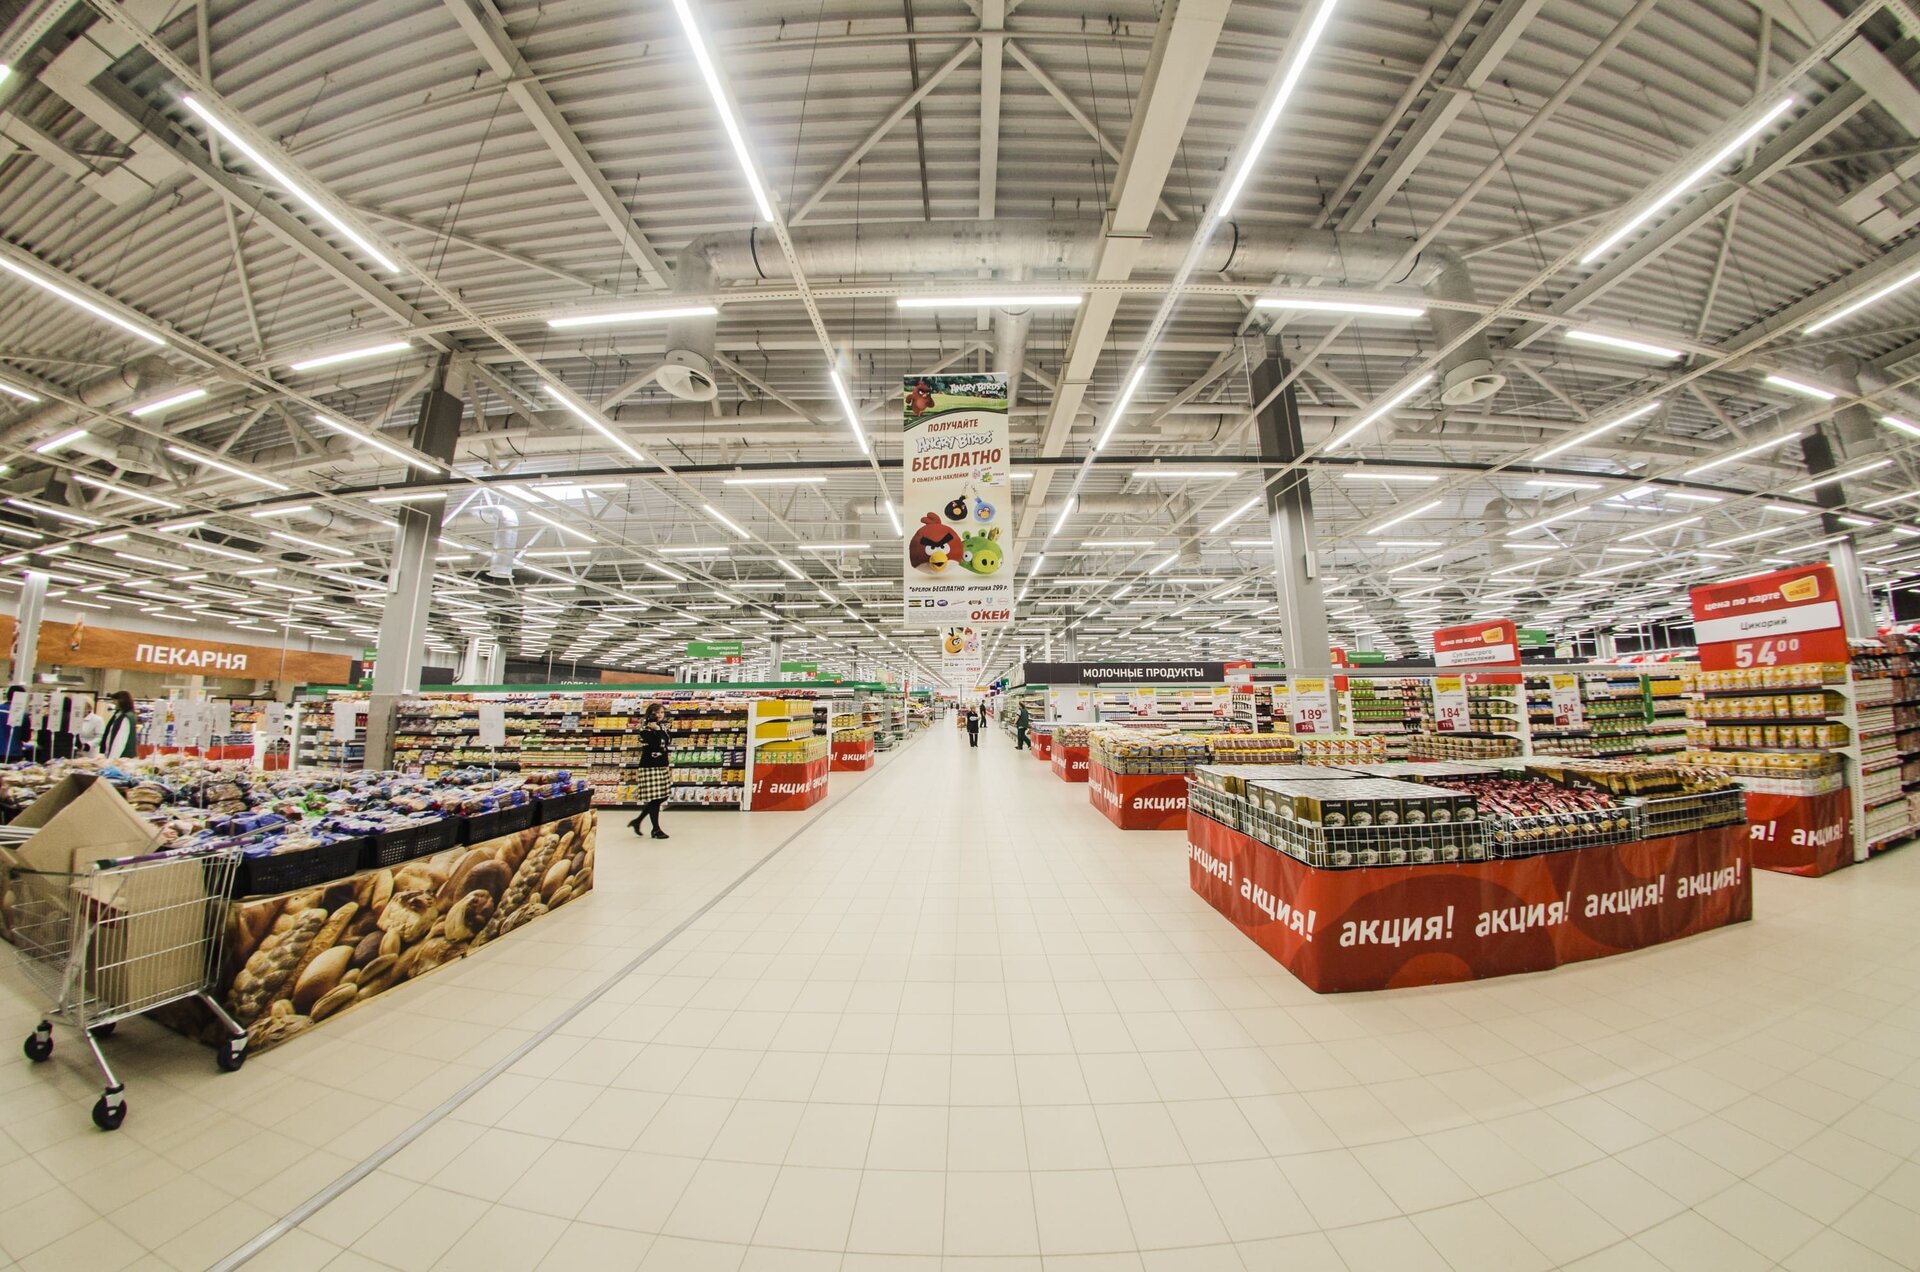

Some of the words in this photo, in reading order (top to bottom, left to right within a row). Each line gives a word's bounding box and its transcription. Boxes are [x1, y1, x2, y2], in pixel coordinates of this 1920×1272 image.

[949, 383, 976, 394] ANGRY
[928, 419, 978, 433] ПОЛУЧАЙТЕ
[916, 436, 955, 453] ANGRY
[955, 431, 993, 449] BIRDS
[943, 472, 969, 480] НАКЛЕЙКИ
[1704, 600, 1731, 611] цена
[1732, 598, 1745, 606] по
[1748, 591, 1781, 604] карте
[1740, 616, 1788, 631] Цикорий
[1464, 636, 1482, 644] карте
[135, 644, 248, 670] ПЕКАРНЯ
[1450, 655, 1496, 664] приготовления
[1083, 668, 1143, 678] МОЛОЧНЫЕ
[1146, 667, 1204, 679] ПРОДУКТЫ
[1441, 707, 1460, 718] 184
[1558, 703, 1574, 713] 184
[1791, 816, 1844, 847] акция!
[1187, 840, 1233, 886] акция!
[1240, 876, 1317, 942] акция!
[1339, 905, 1455, 948] акция!
[1475, 891, 1571, 938] акция!
[1583, 874, 1665, 917] акция!
[1677, 857, 1742, 900] акция!
